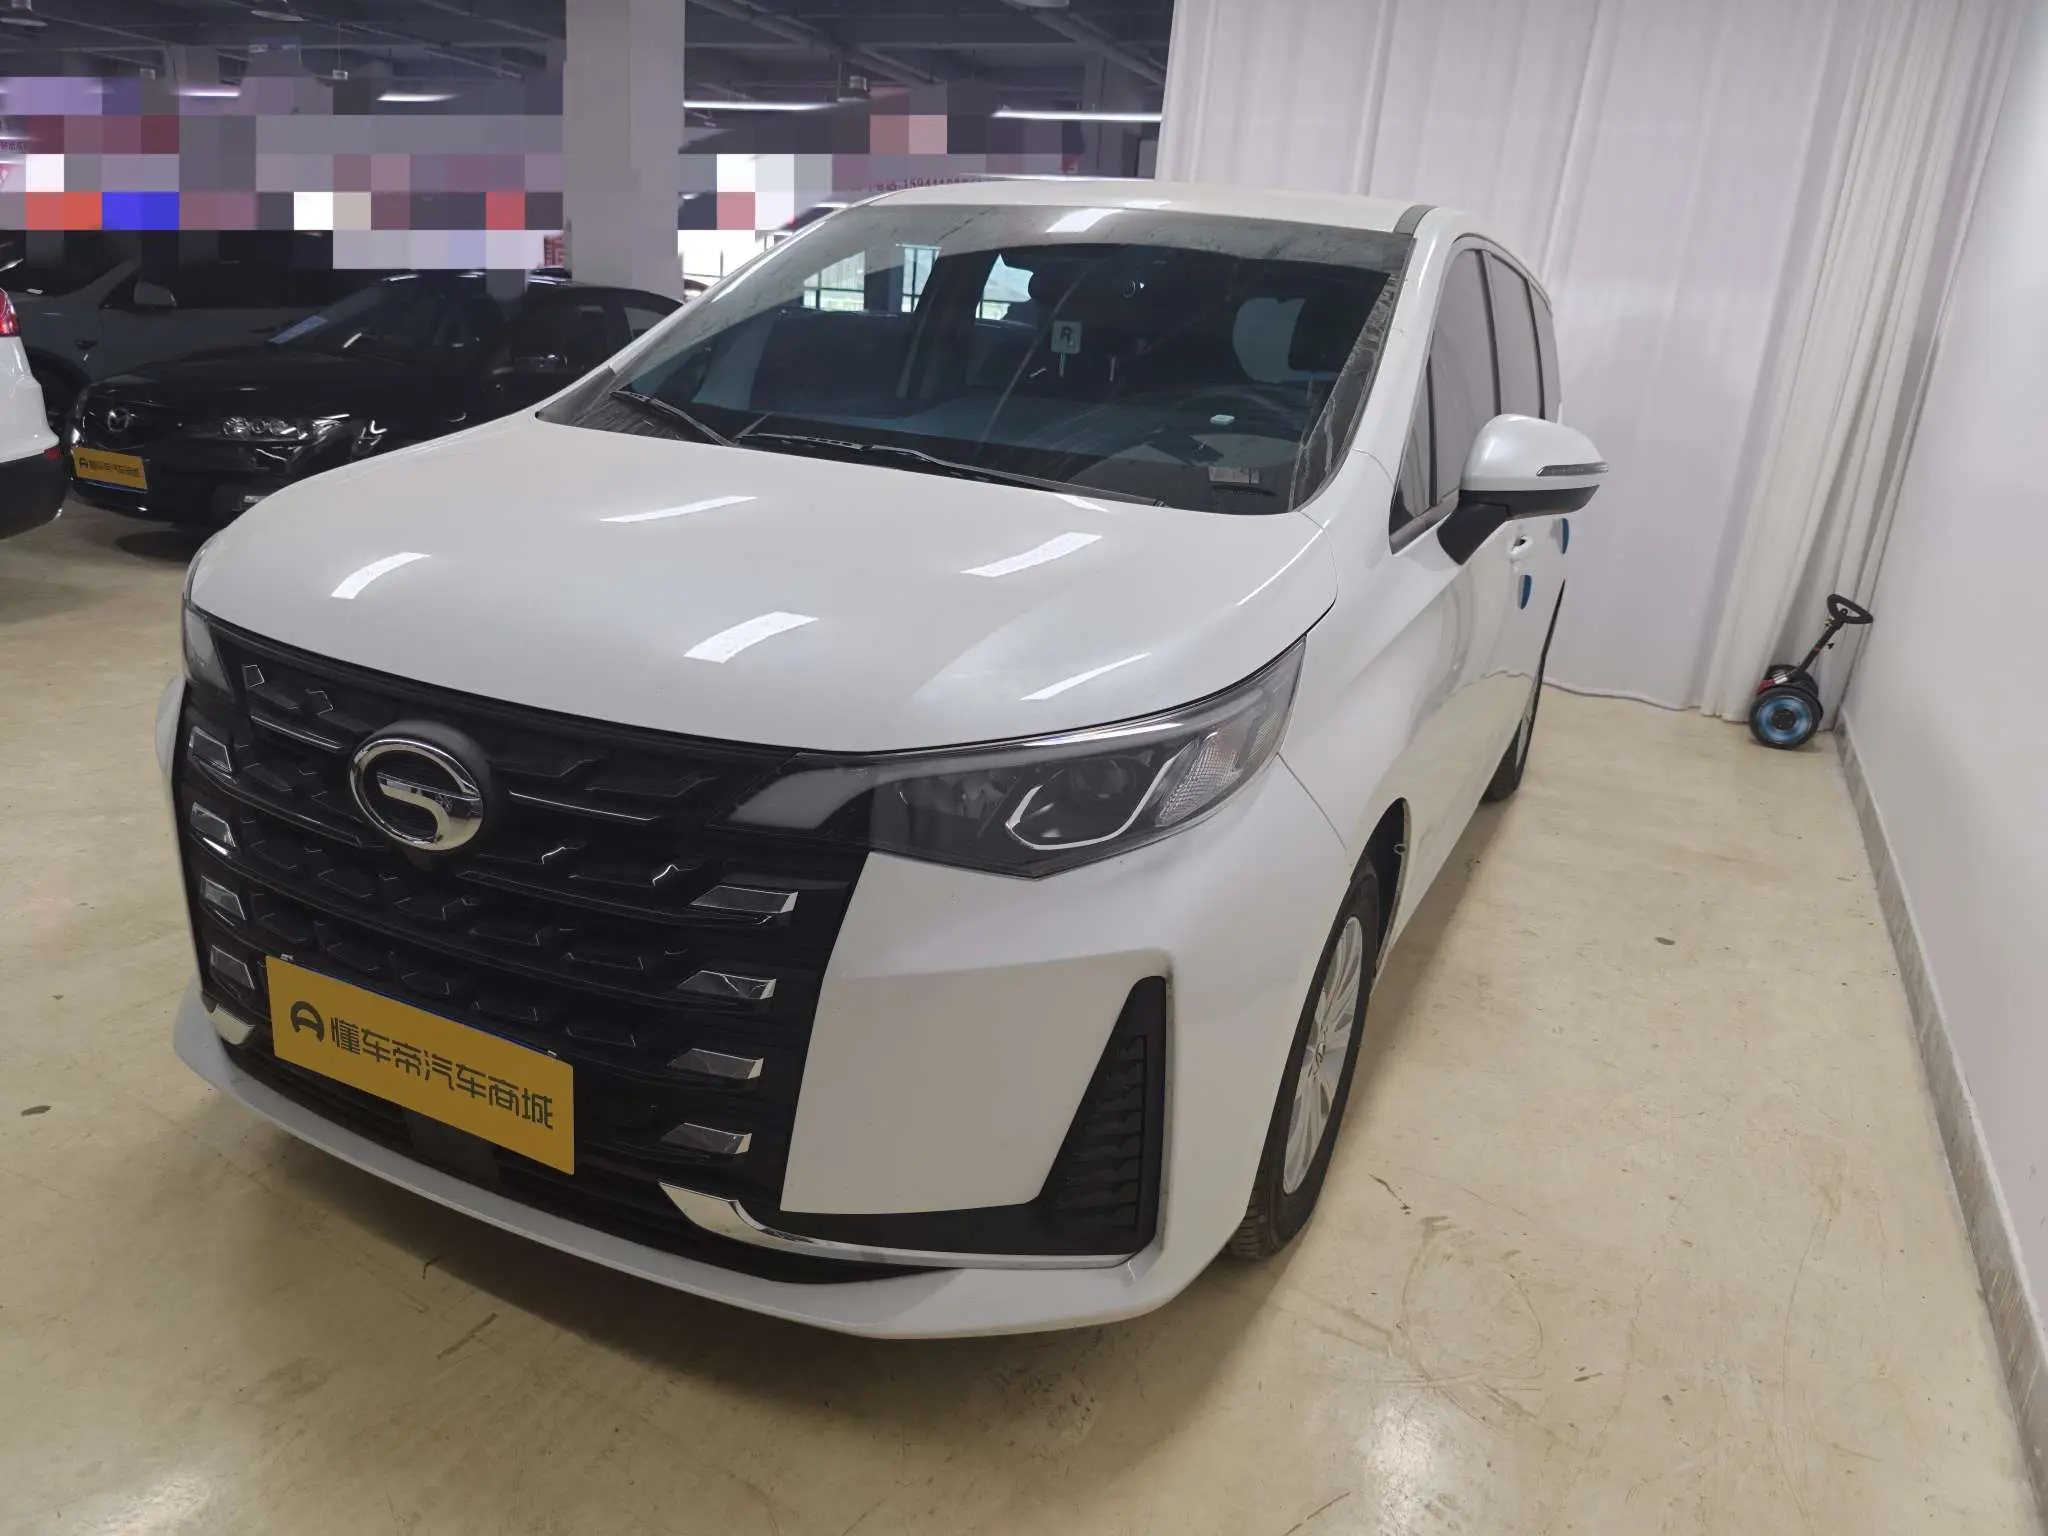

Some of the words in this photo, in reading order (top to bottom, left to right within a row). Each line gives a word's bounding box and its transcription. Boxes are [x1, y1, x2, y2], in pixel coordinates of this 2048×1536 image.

[330, 1016, 554, 1130] 懂车帝汽车商城
